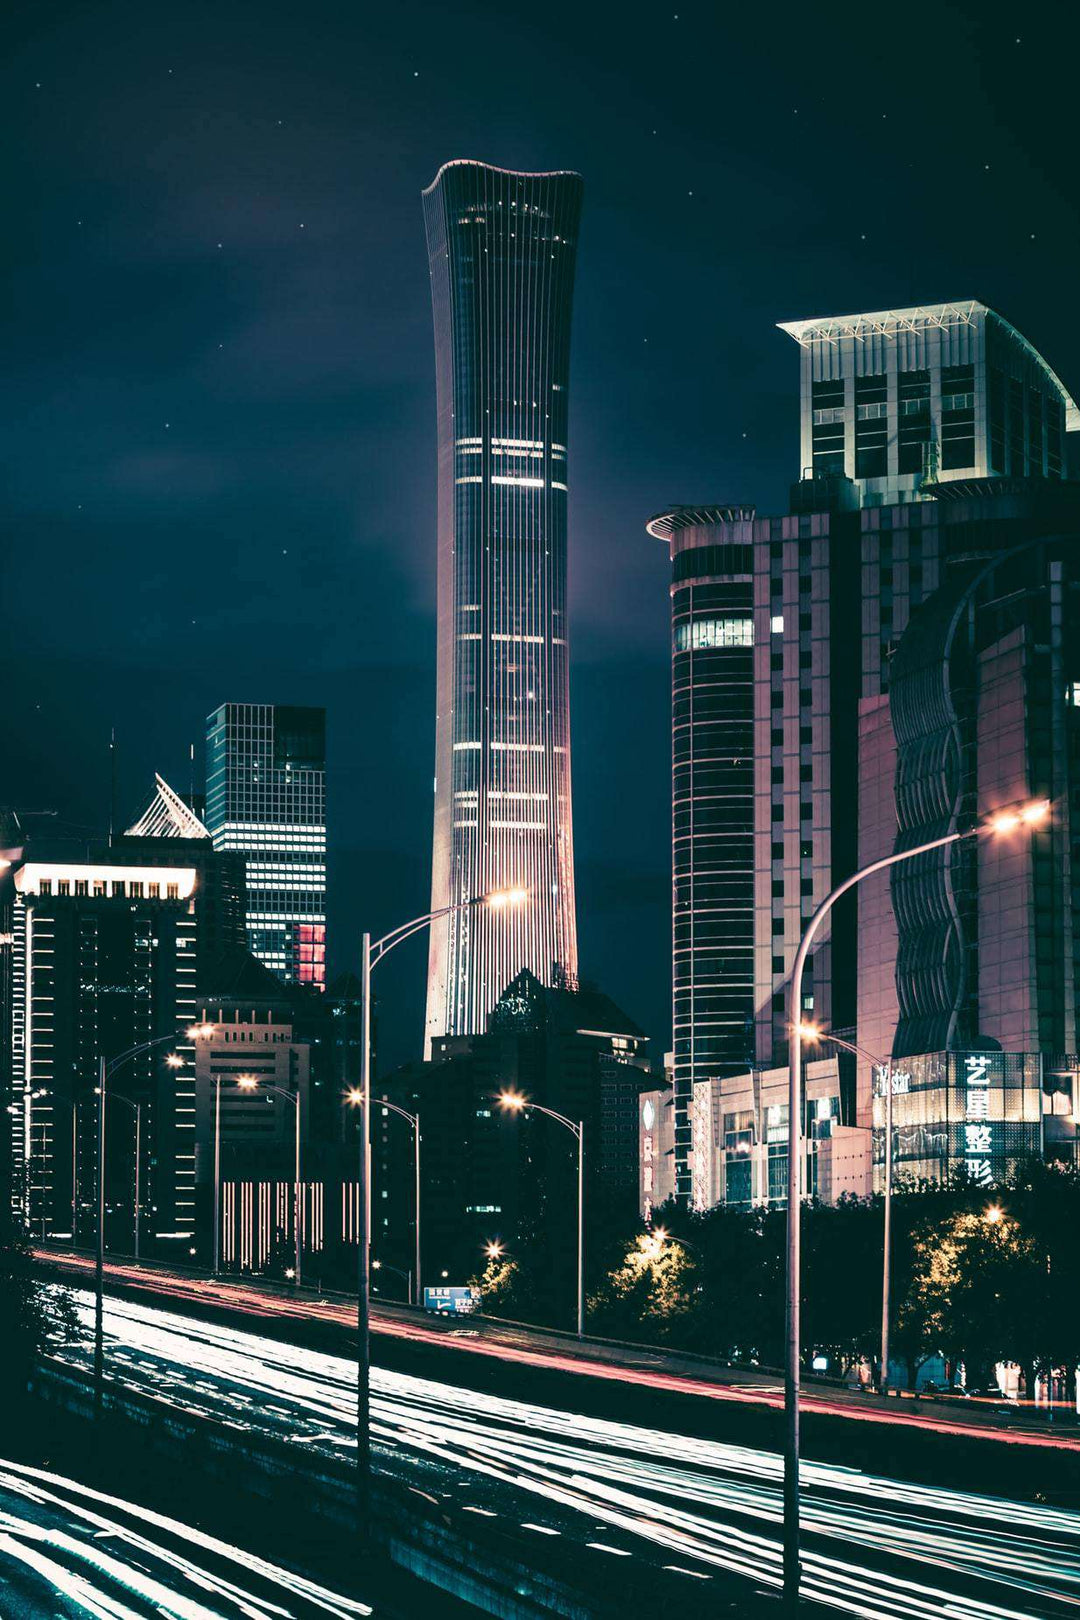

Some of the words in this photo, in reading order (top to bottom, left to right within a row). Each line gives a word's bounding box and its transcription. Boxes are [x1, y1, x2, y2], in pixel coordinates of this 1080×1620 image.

[879, 1066, 910, 1096] Ystar
[964, 1056, 993, 1186] 艺星整形
